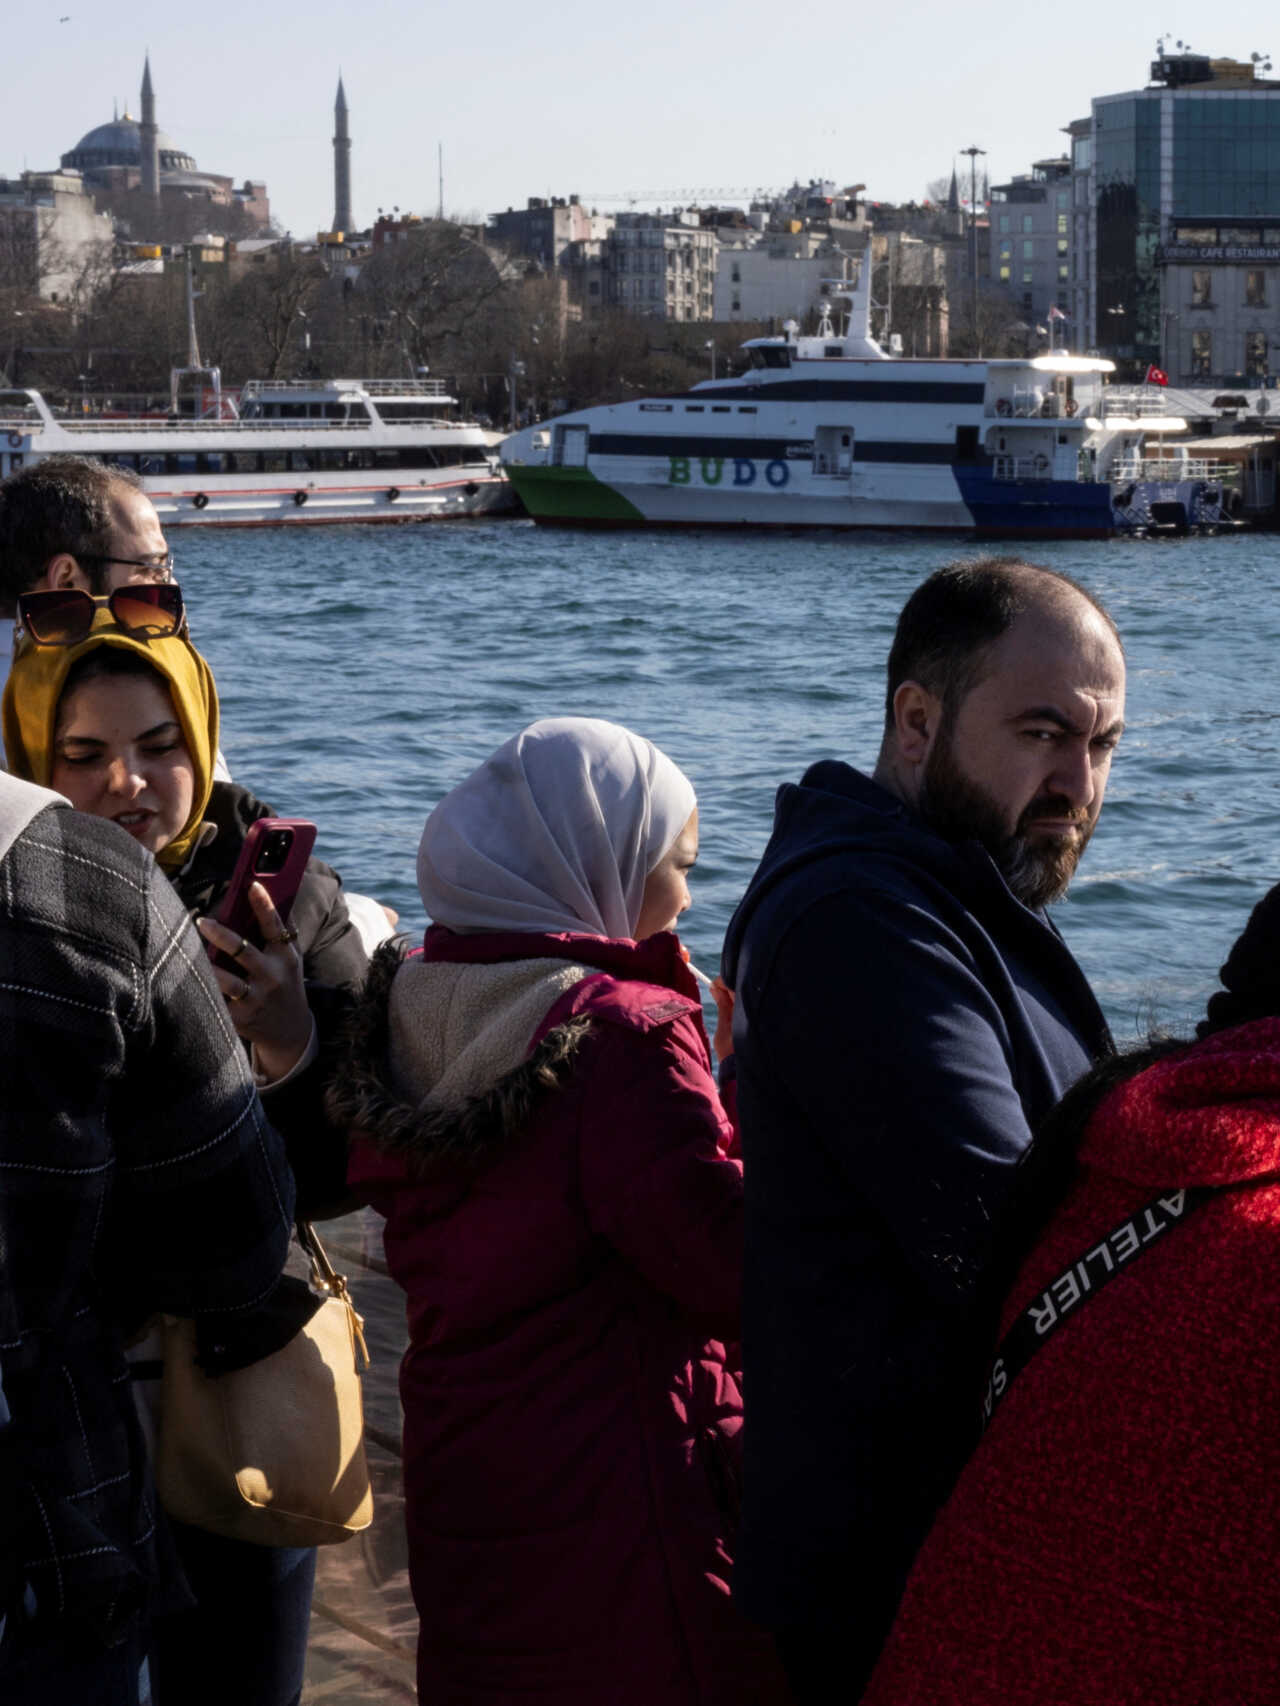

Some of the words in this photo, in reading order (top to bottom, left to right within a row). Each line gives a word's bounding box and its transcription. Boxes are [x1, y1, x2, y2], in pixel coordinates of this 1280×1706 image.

[1200, 247, 1223, 258] CAFE
[669, 457, 789, 487] BUDO
[1027, 1188, 1186, 1336] ATELIER
